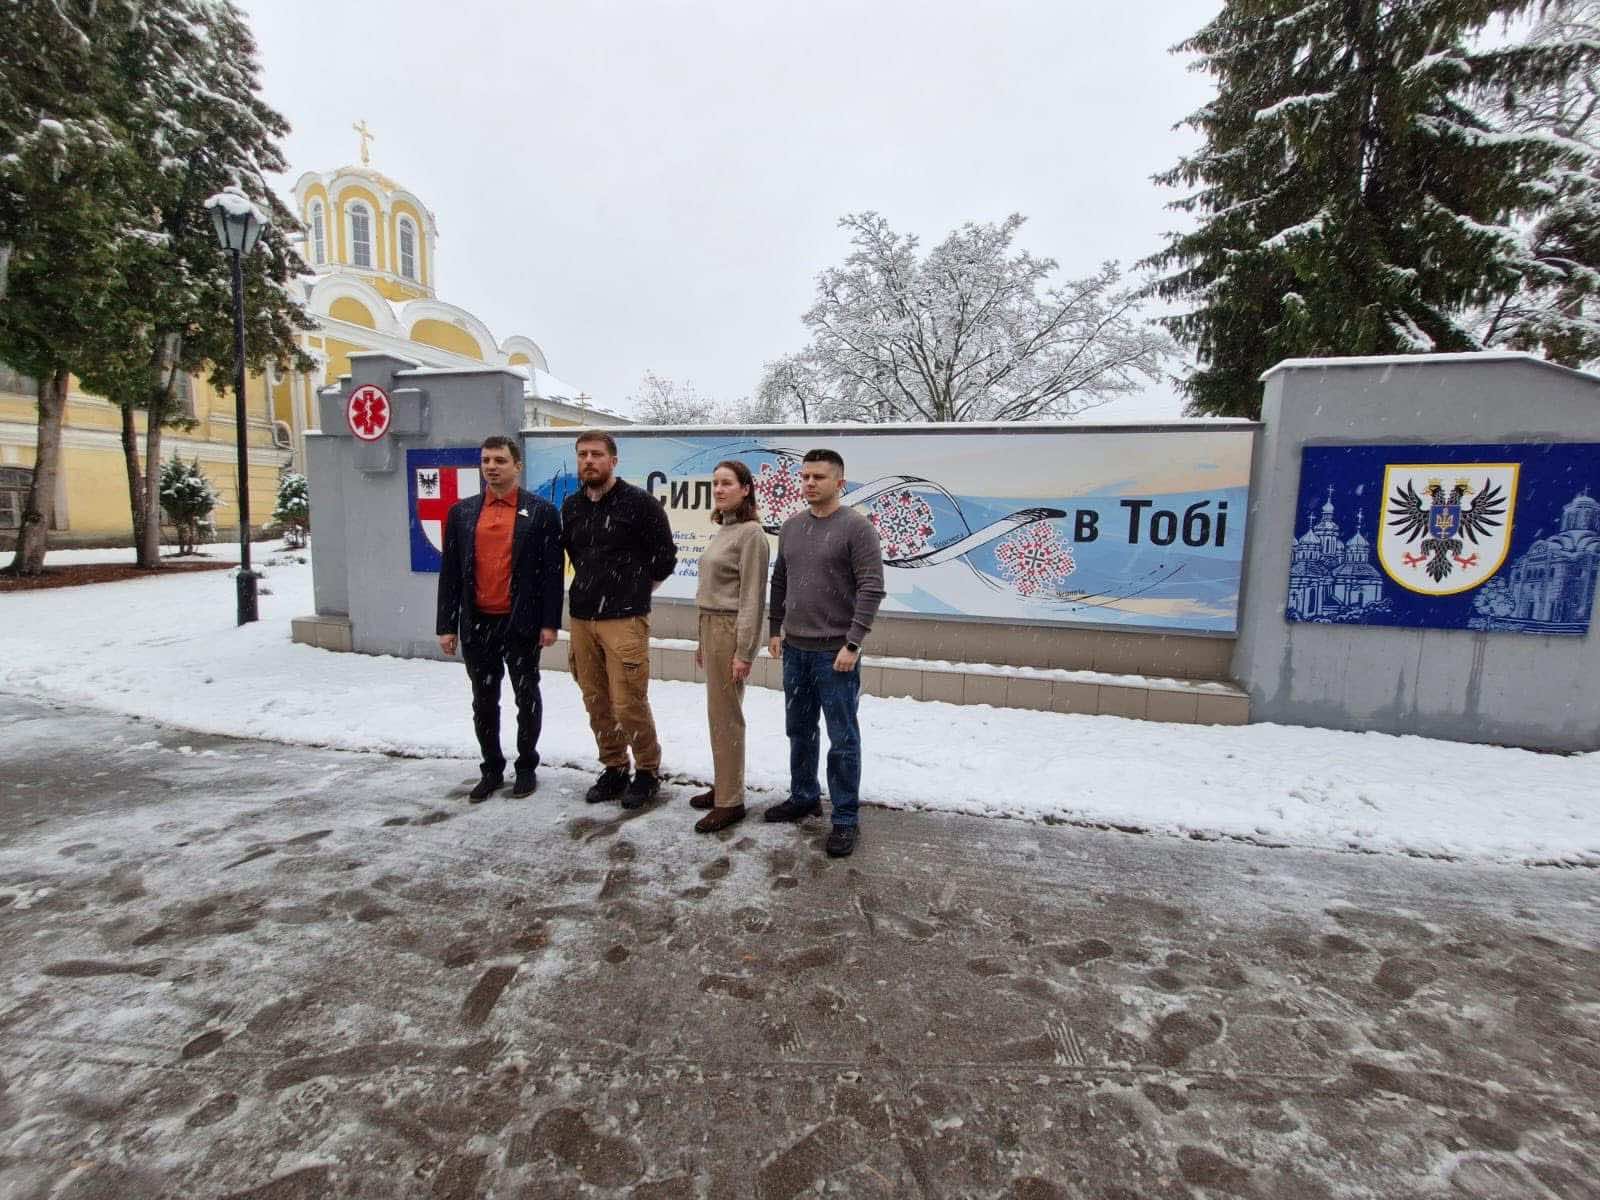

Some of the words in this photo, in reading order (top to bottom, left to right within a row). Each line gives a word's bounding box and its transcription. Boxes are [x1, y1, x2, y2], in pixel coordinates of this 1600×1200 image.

[646, 470, 712, 510] Сил
[1073, 509, 1100, 543] в
[1119, 499, 1228, 547] Тобі
